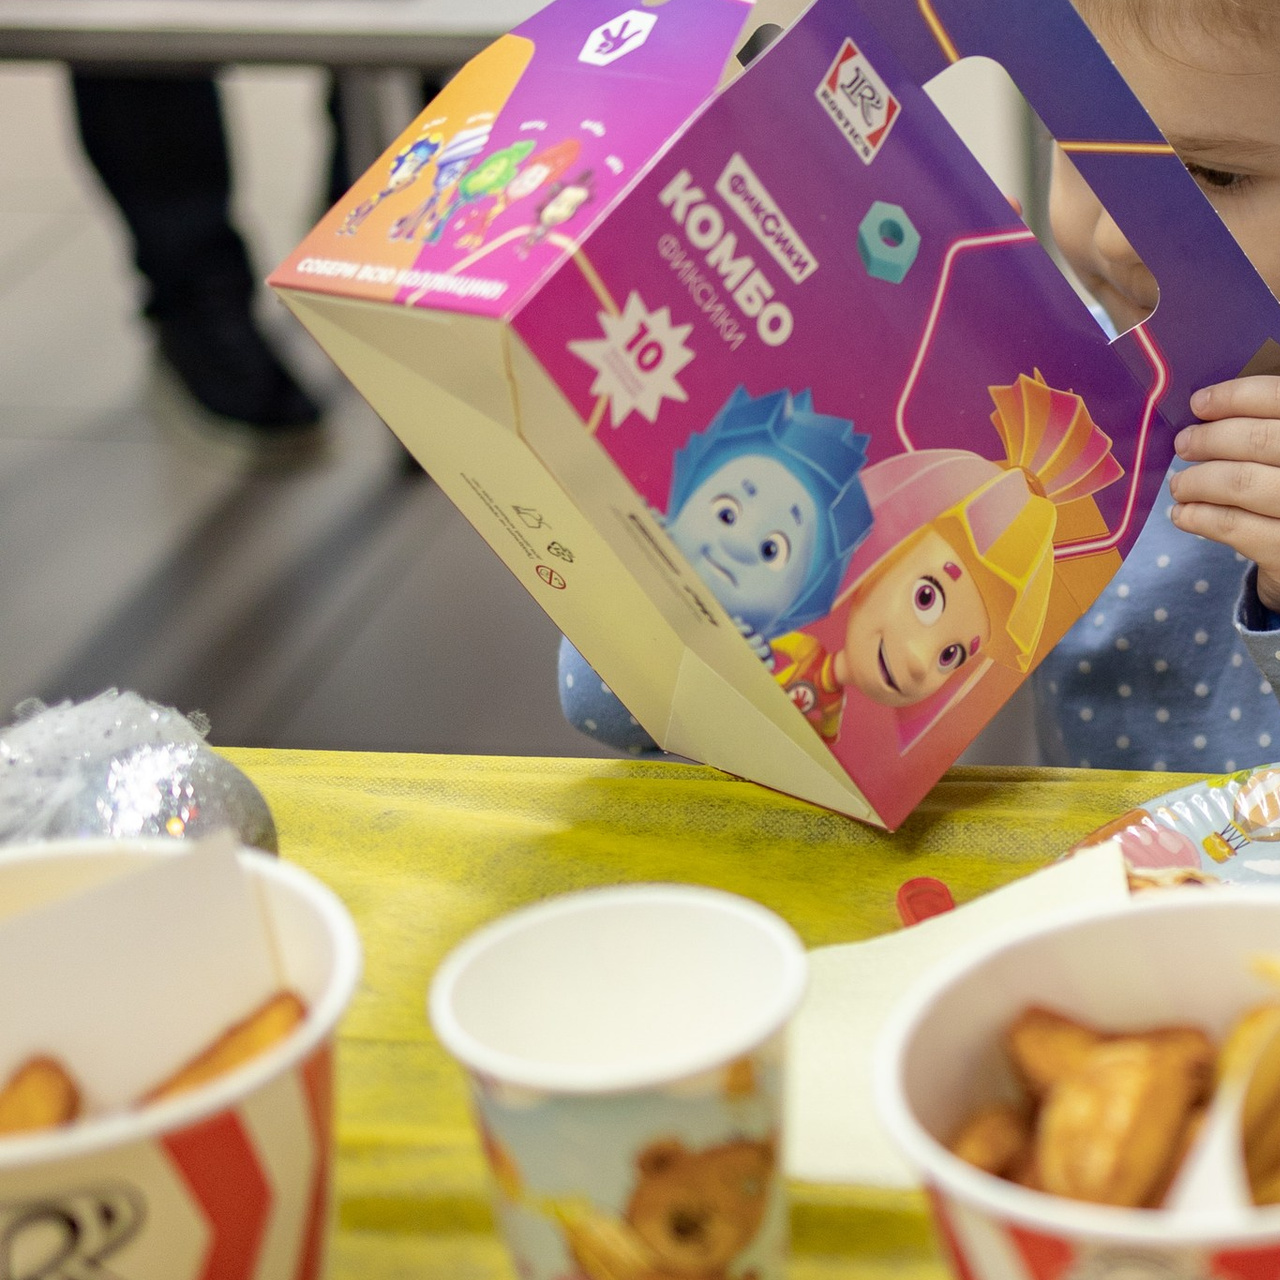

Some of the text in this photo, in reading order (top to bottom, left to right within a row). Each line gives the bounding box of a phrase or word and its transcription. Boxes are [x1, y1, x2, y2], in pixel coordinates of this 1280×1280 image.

[657, 168, 795, 348] КОМБО
[729, 173, 810, 276] ФИКСИКИ
[624, 322, 664, 373] 10
[657, 232, 748, 353] ФИКСИКИ
